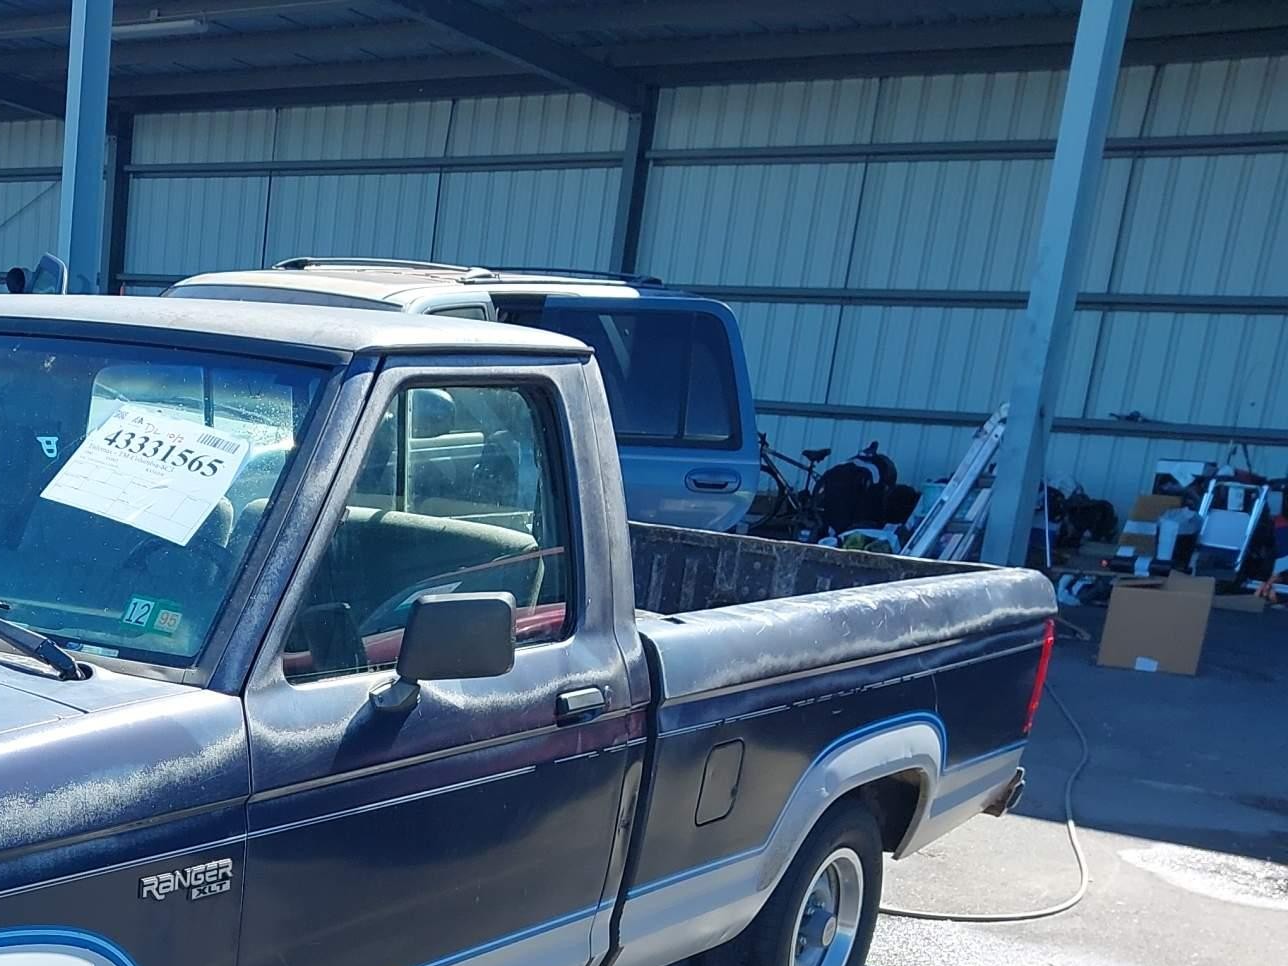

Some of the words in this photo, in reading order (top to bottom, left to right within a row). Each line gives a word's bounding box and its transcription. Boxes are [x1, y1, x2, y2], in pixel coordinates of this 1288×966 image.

[104, 429, 225, 477] 43331565
[125, 602, 151, 625] 12
[195, 881, 228, 898] XLT
